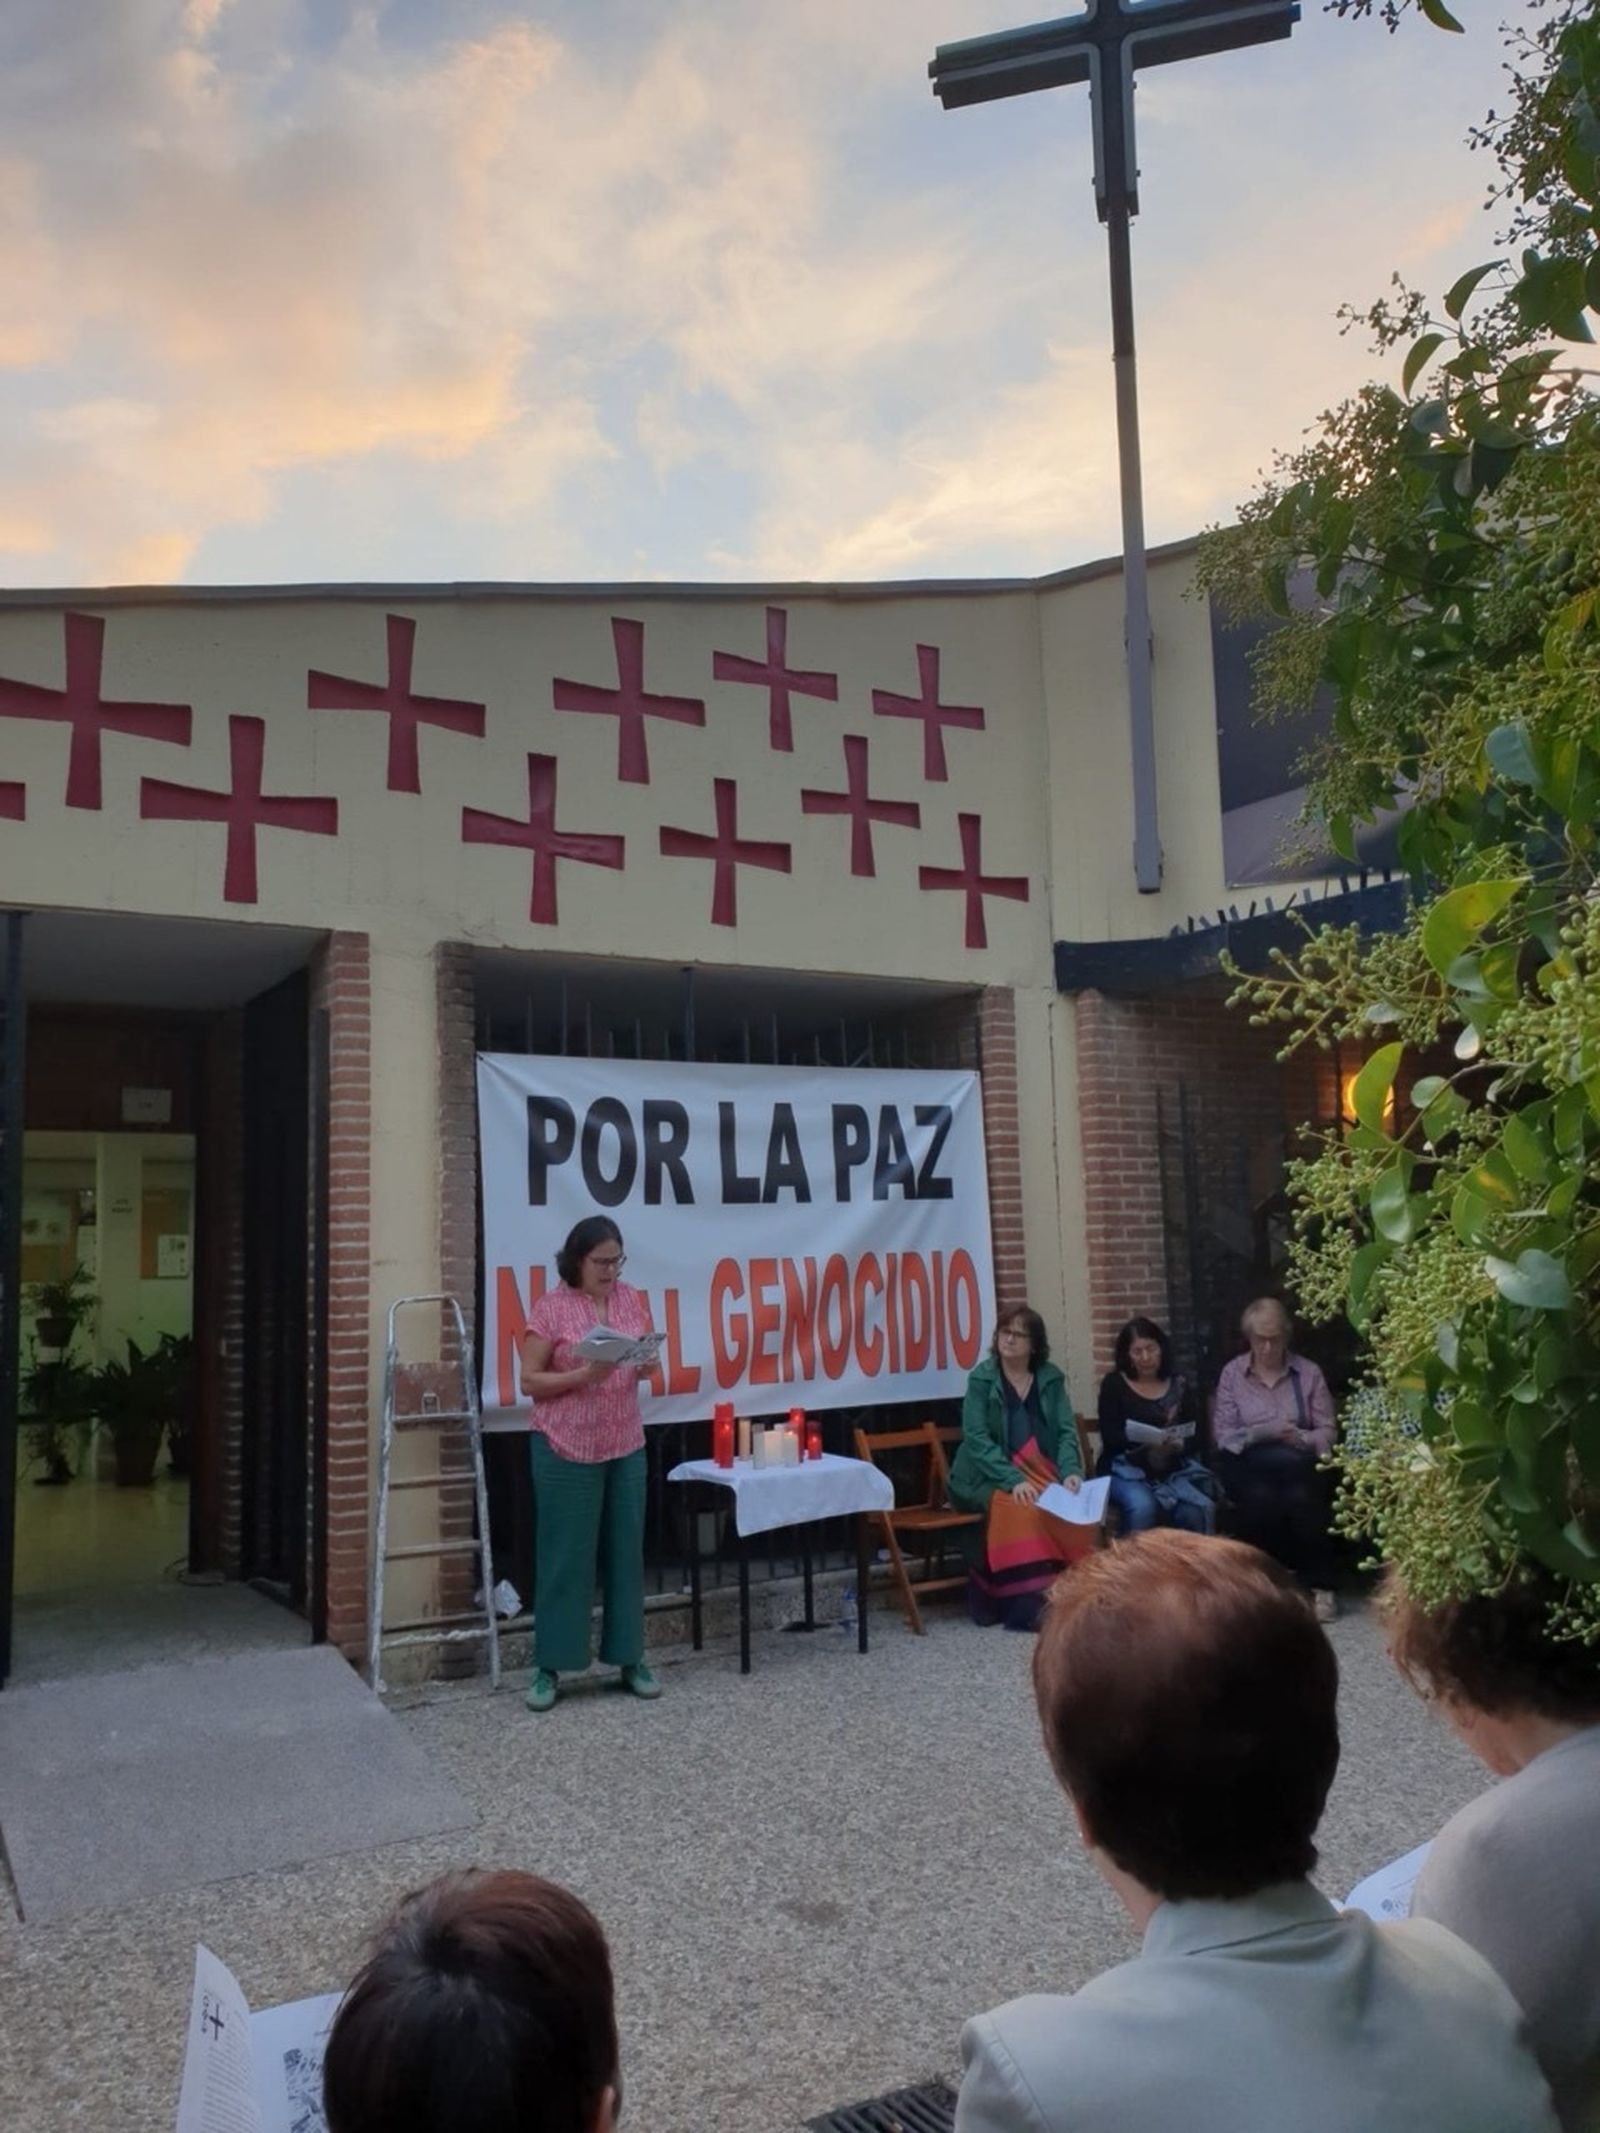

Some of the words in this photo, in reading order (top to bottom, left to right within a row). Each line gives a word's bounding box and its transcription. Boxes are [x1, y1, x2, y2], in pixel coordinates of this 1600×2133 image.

[526, 1095, 695, 1206] POR
[718, 1101, 812, 1204] LA
[831, 1103, 954, 1201] PAZ
[710, 1248, 982, 1390] GENOCIDIO
